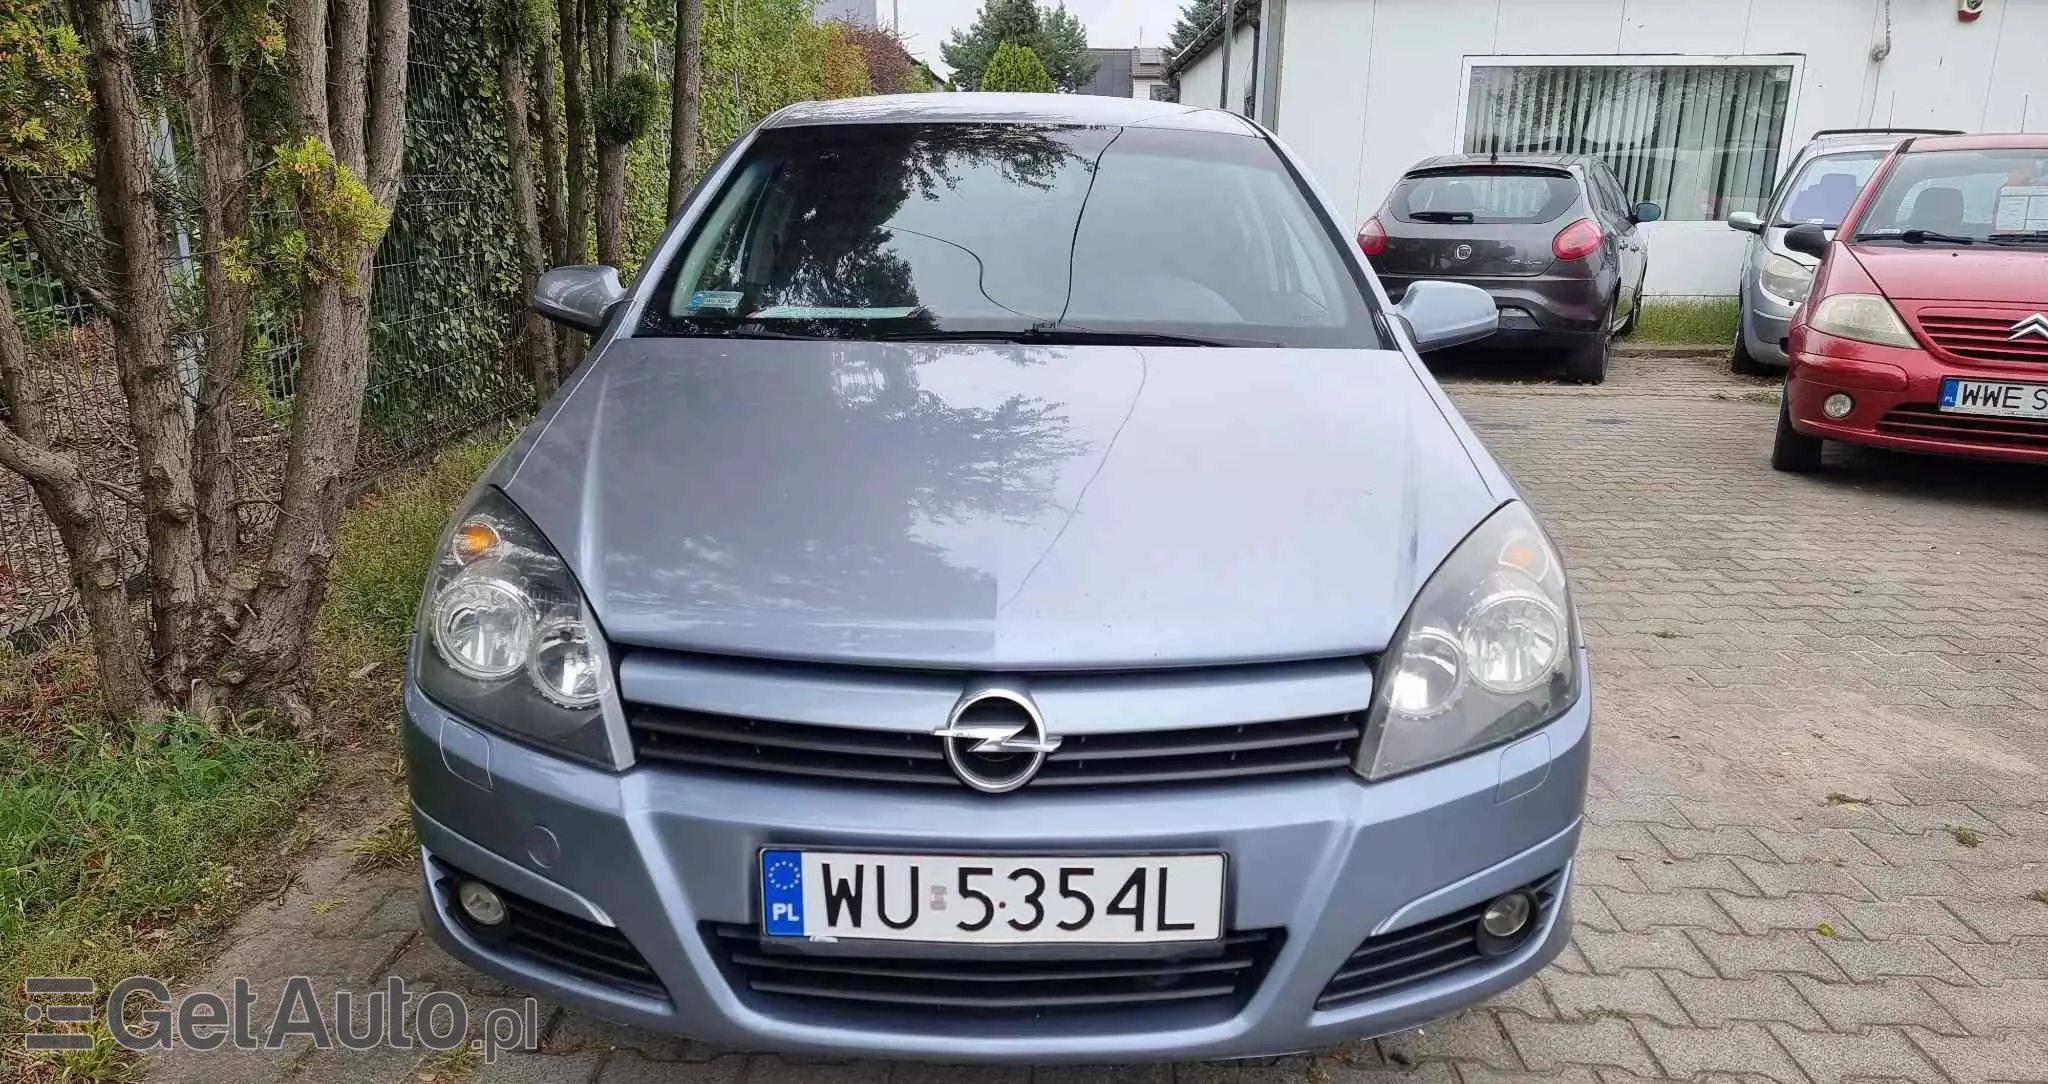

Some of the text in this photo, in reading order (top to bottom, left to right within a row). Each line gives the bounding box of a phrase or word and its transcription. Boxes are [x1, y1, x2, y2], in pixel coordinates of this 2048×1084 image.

[1962, 384, 2024, 409] WWE
[821, 863, 1195, 931] WU 5354L
[772, 902, 800, 922] PL
